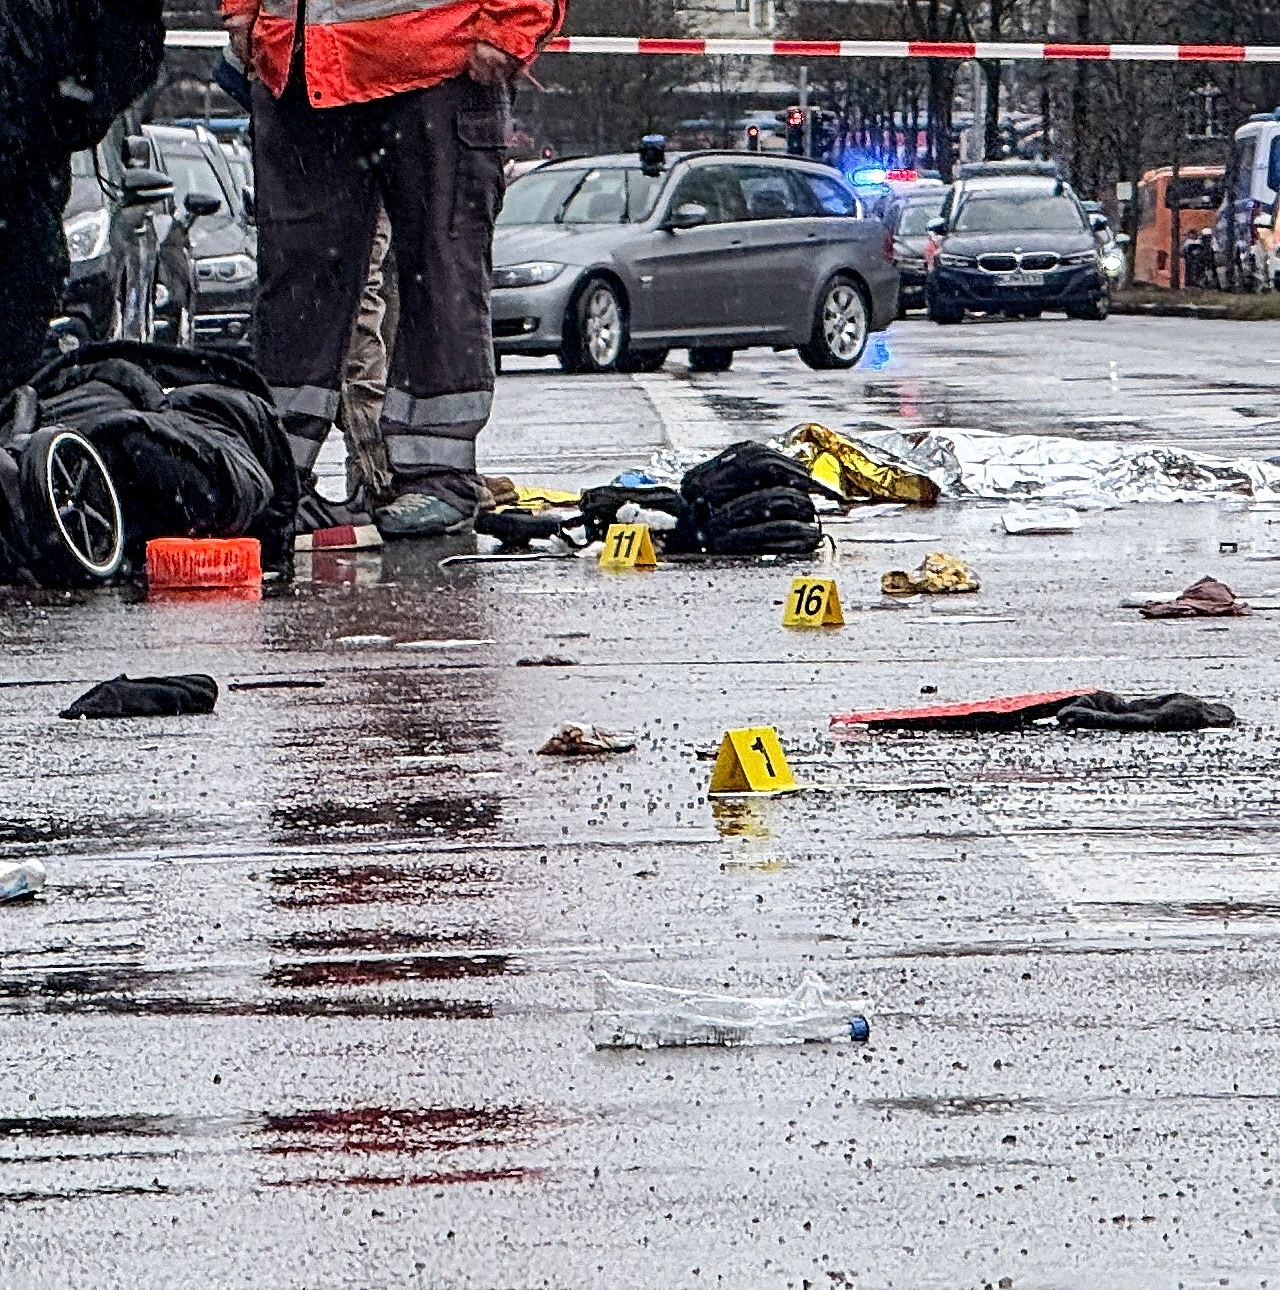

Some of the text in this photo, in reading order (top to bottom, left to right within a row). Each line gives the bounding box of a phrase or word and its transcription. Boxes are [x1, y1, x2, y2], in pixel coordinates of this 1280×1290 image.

[613, 530, 637, 559] 11
[793, 583, 826, 616] 16
[750, 736, 777, 778] 1
